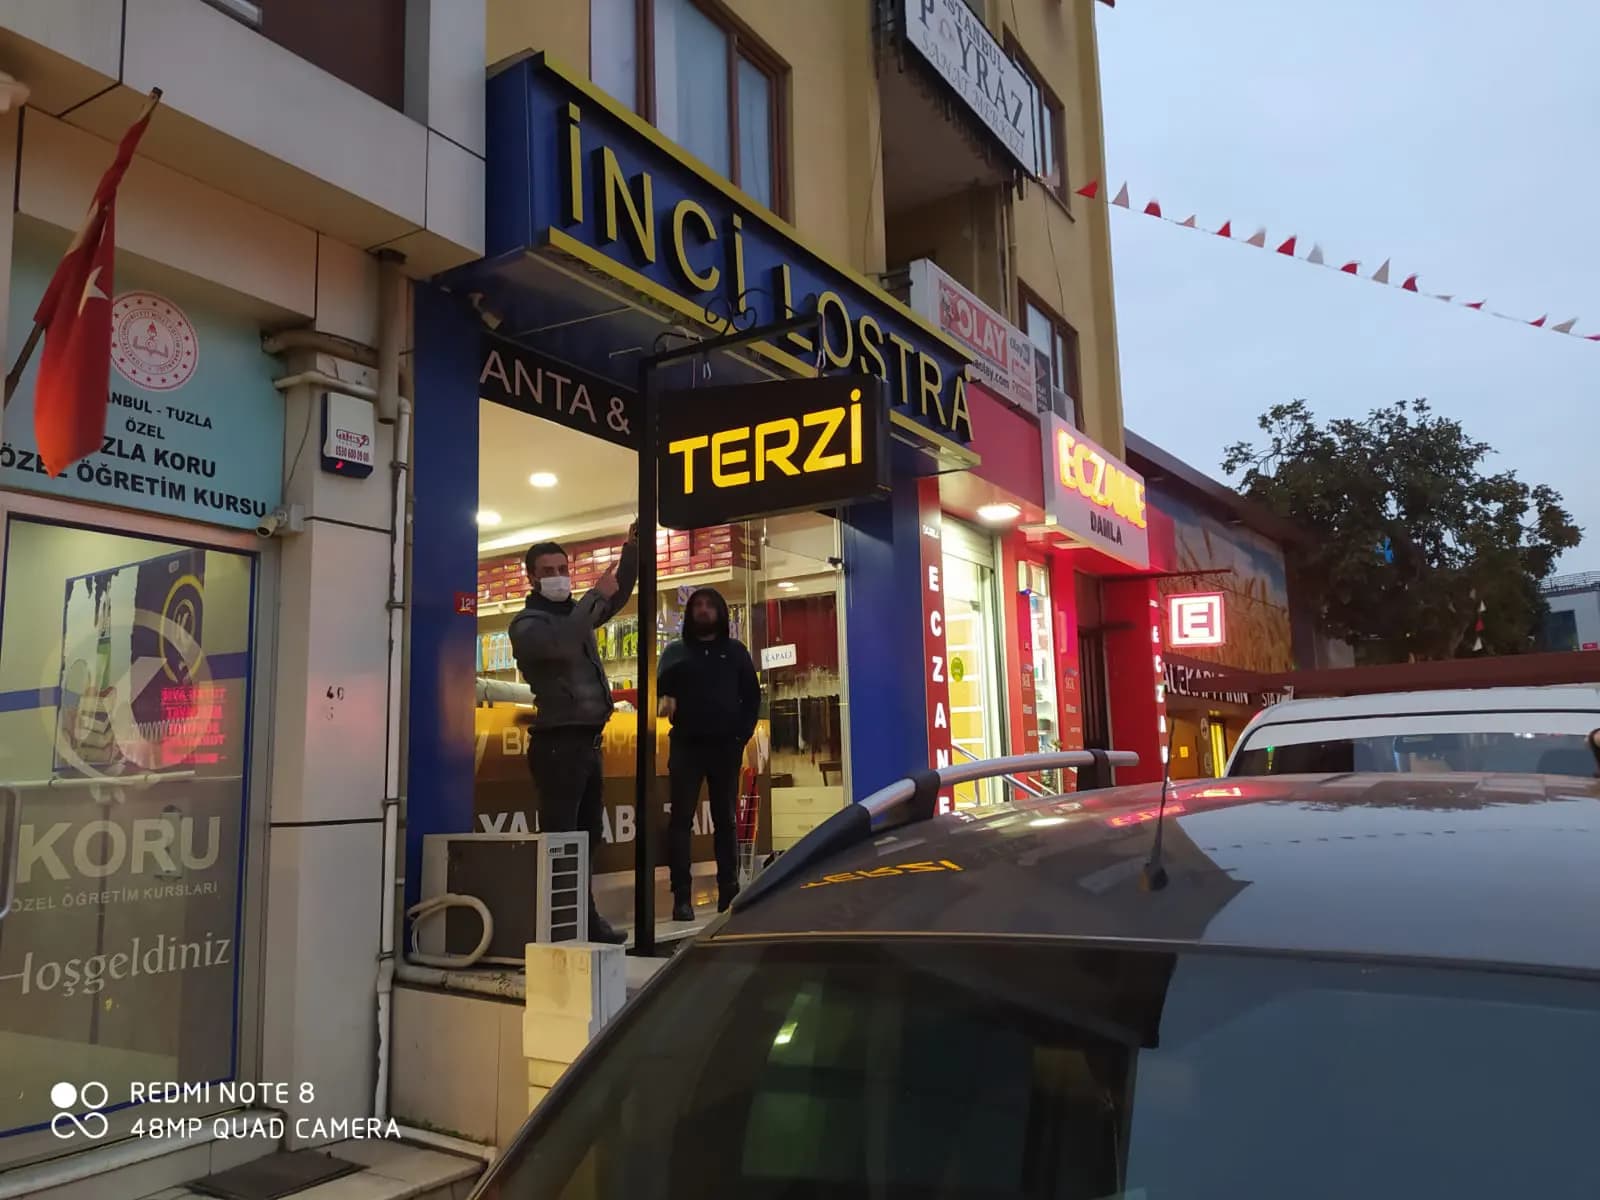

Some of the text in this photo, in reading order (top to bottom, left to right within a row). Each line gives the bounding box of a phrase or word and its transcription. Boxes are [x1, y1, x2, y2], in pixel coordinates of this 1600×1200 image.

[942, 0, 1004, 75] STANBUL
[568, 101, 747, 315] İNCİ
[105, 391, 152, 414] NBUL
[166, 406, 213, 429] TUZLA
[125, 416, 166, 440] ÖZEL
[606, 396, 631, 435] &
[100, 436, 217, 478] ZLA KORU
[668, 388, 863, 495] TERZİ
[77, 459, 187, 502] ÖĞRETİM
[194, 487, 267, 518] KURSU
[1089, 510, 1123, 546] DAMLA
[15, 816, 221, 885] KORU
